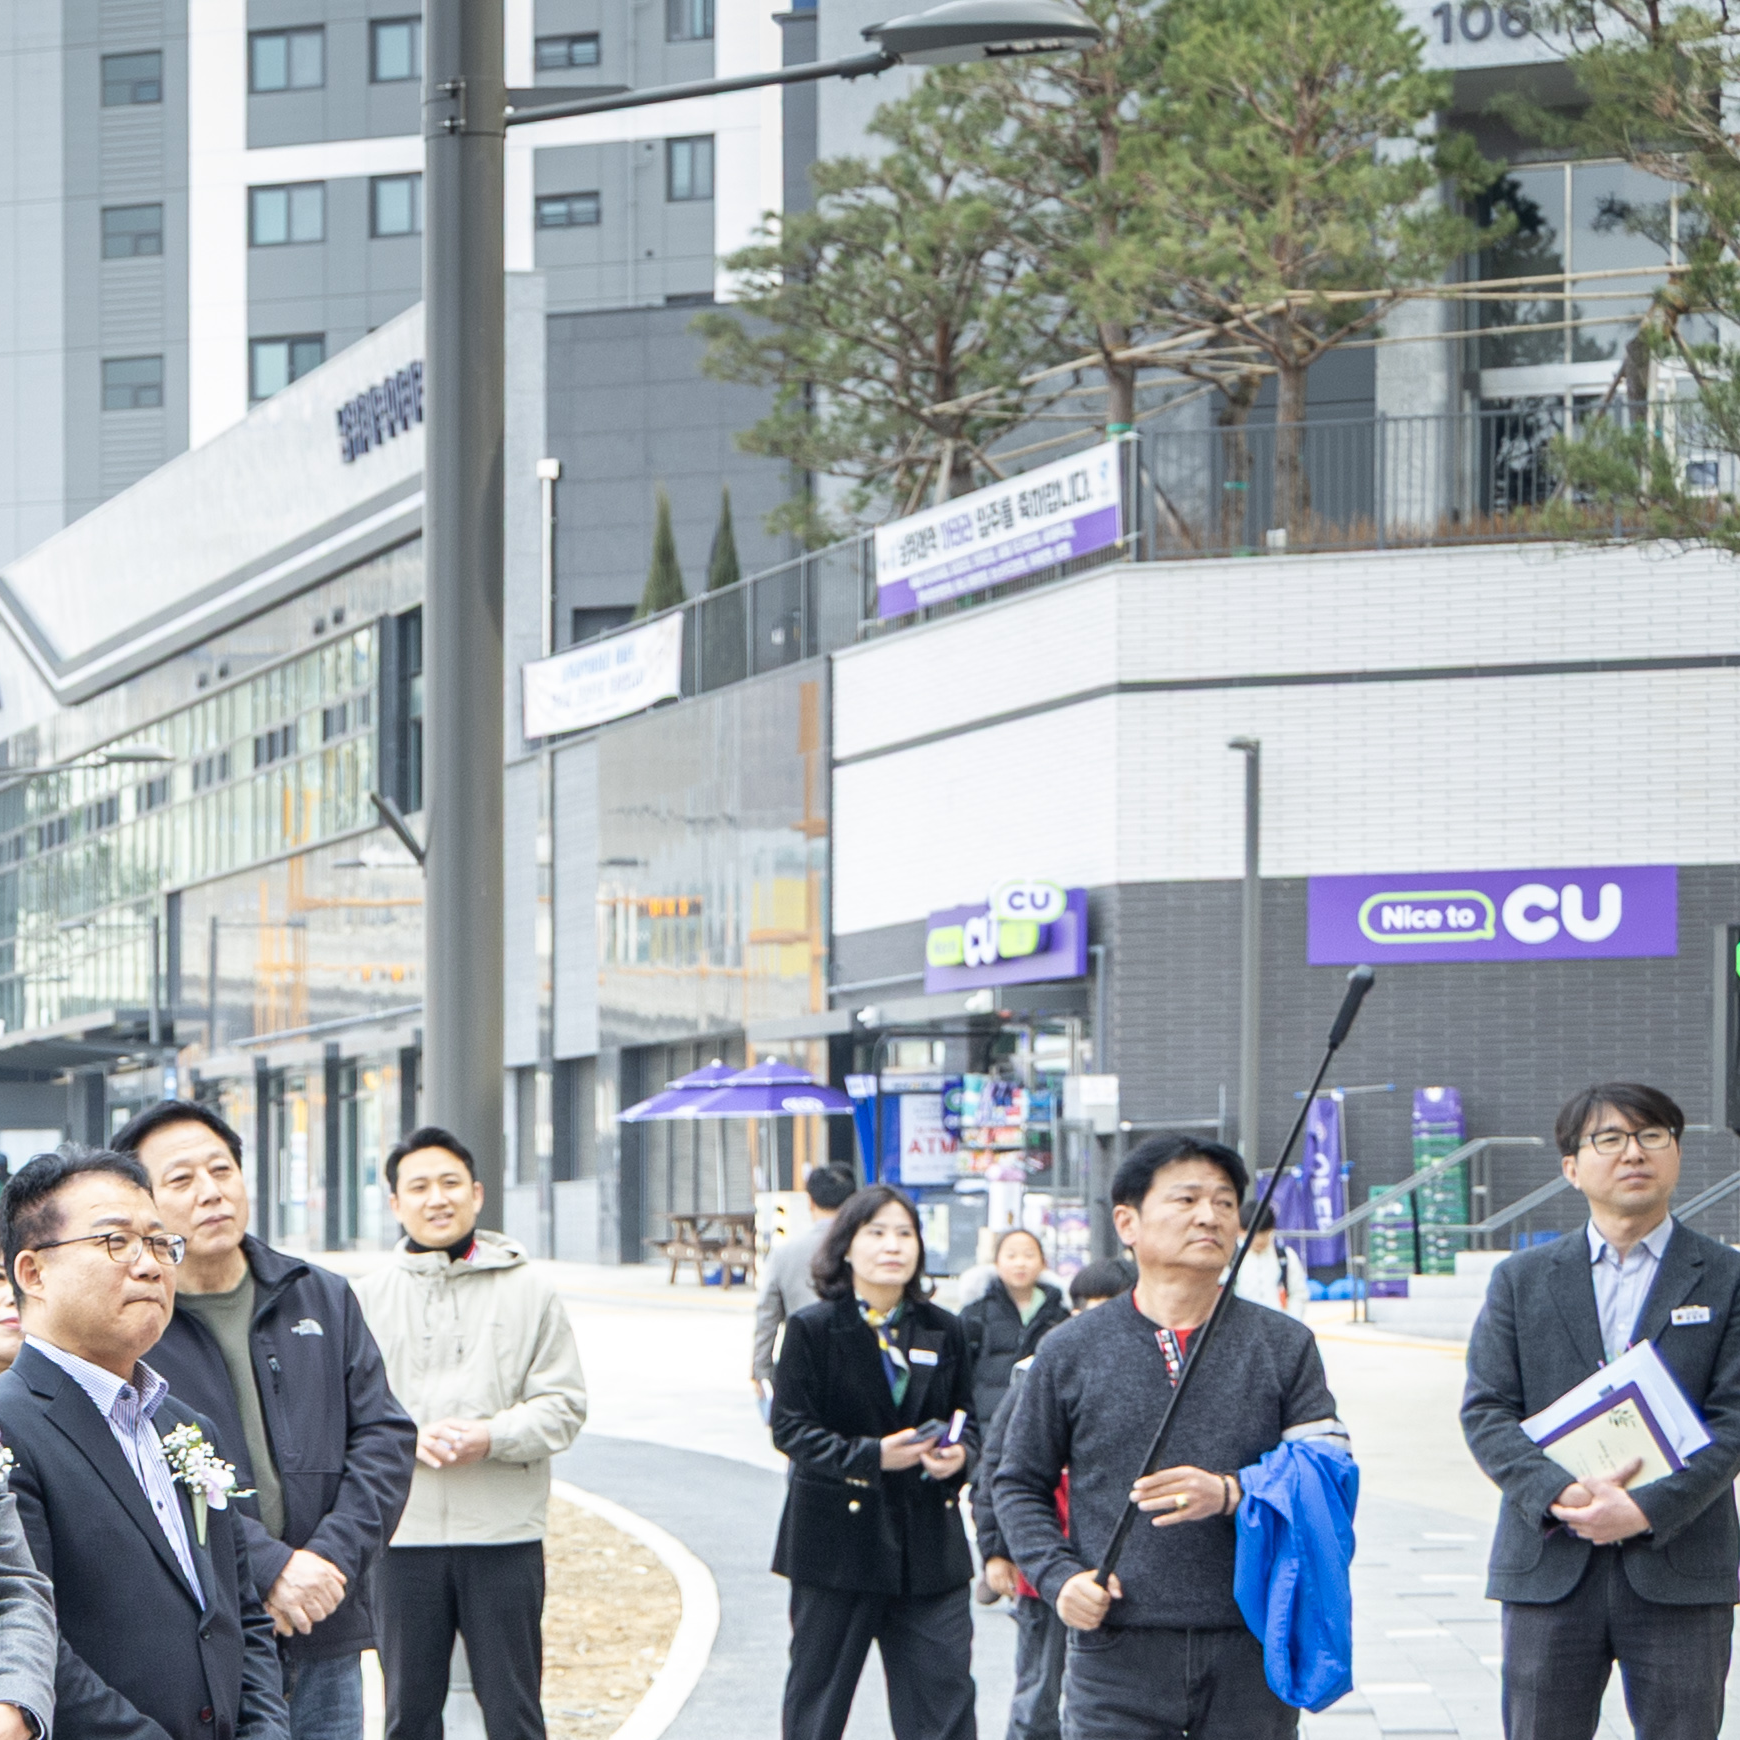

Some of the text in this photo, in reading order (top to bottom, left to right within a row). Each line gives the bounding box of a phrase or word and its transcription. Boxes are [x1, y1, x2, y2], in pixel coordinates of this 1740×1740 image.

[1008, 891, 1050, 911] CU
[1381, 882, 1622, 944] Nice to CU
[907, 1137, 958, 1154] ATM
